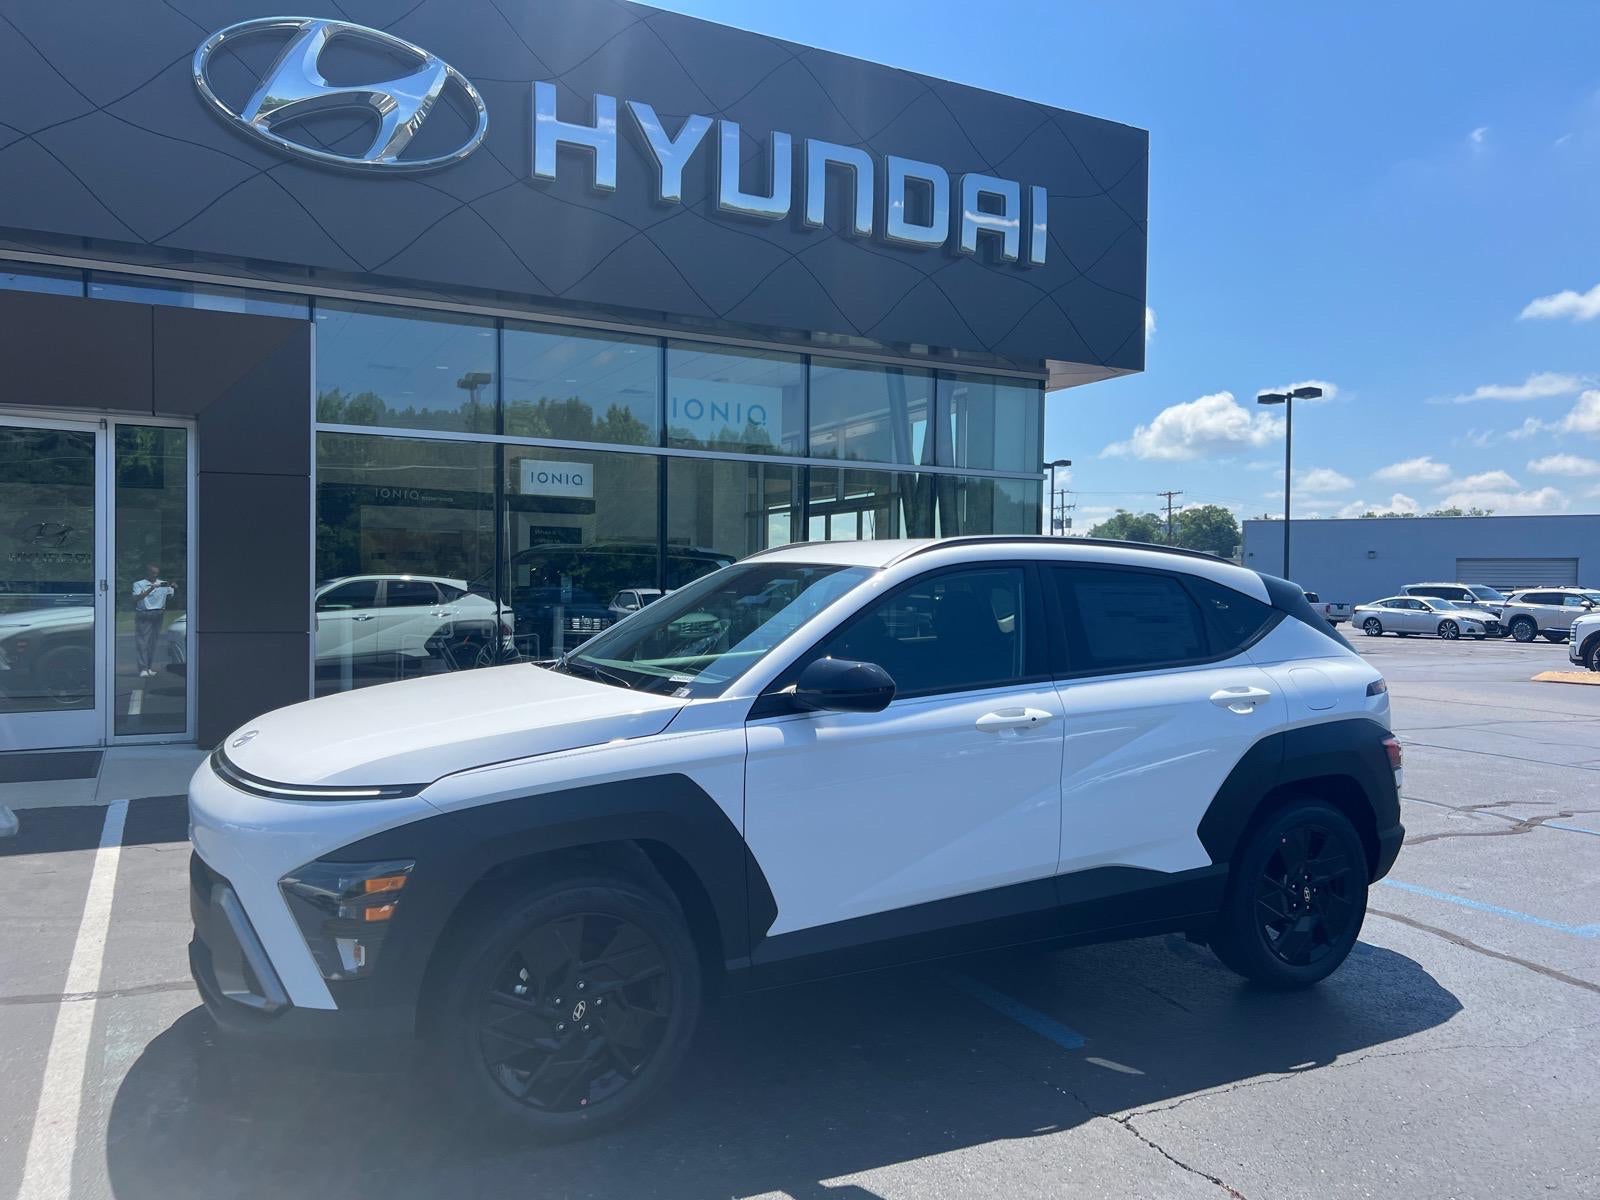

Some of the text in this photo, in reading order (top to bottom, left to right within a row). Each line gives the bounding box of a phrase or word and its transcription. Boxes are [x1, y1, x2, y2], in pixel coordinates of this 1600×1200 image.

[532, 80, 1048, 265] HYUNDAI
[672, 397, 766, 426] IONIQ
[531, 472, 584, 486] IONIQ
[375, 487, 419, 500] IONIQ
